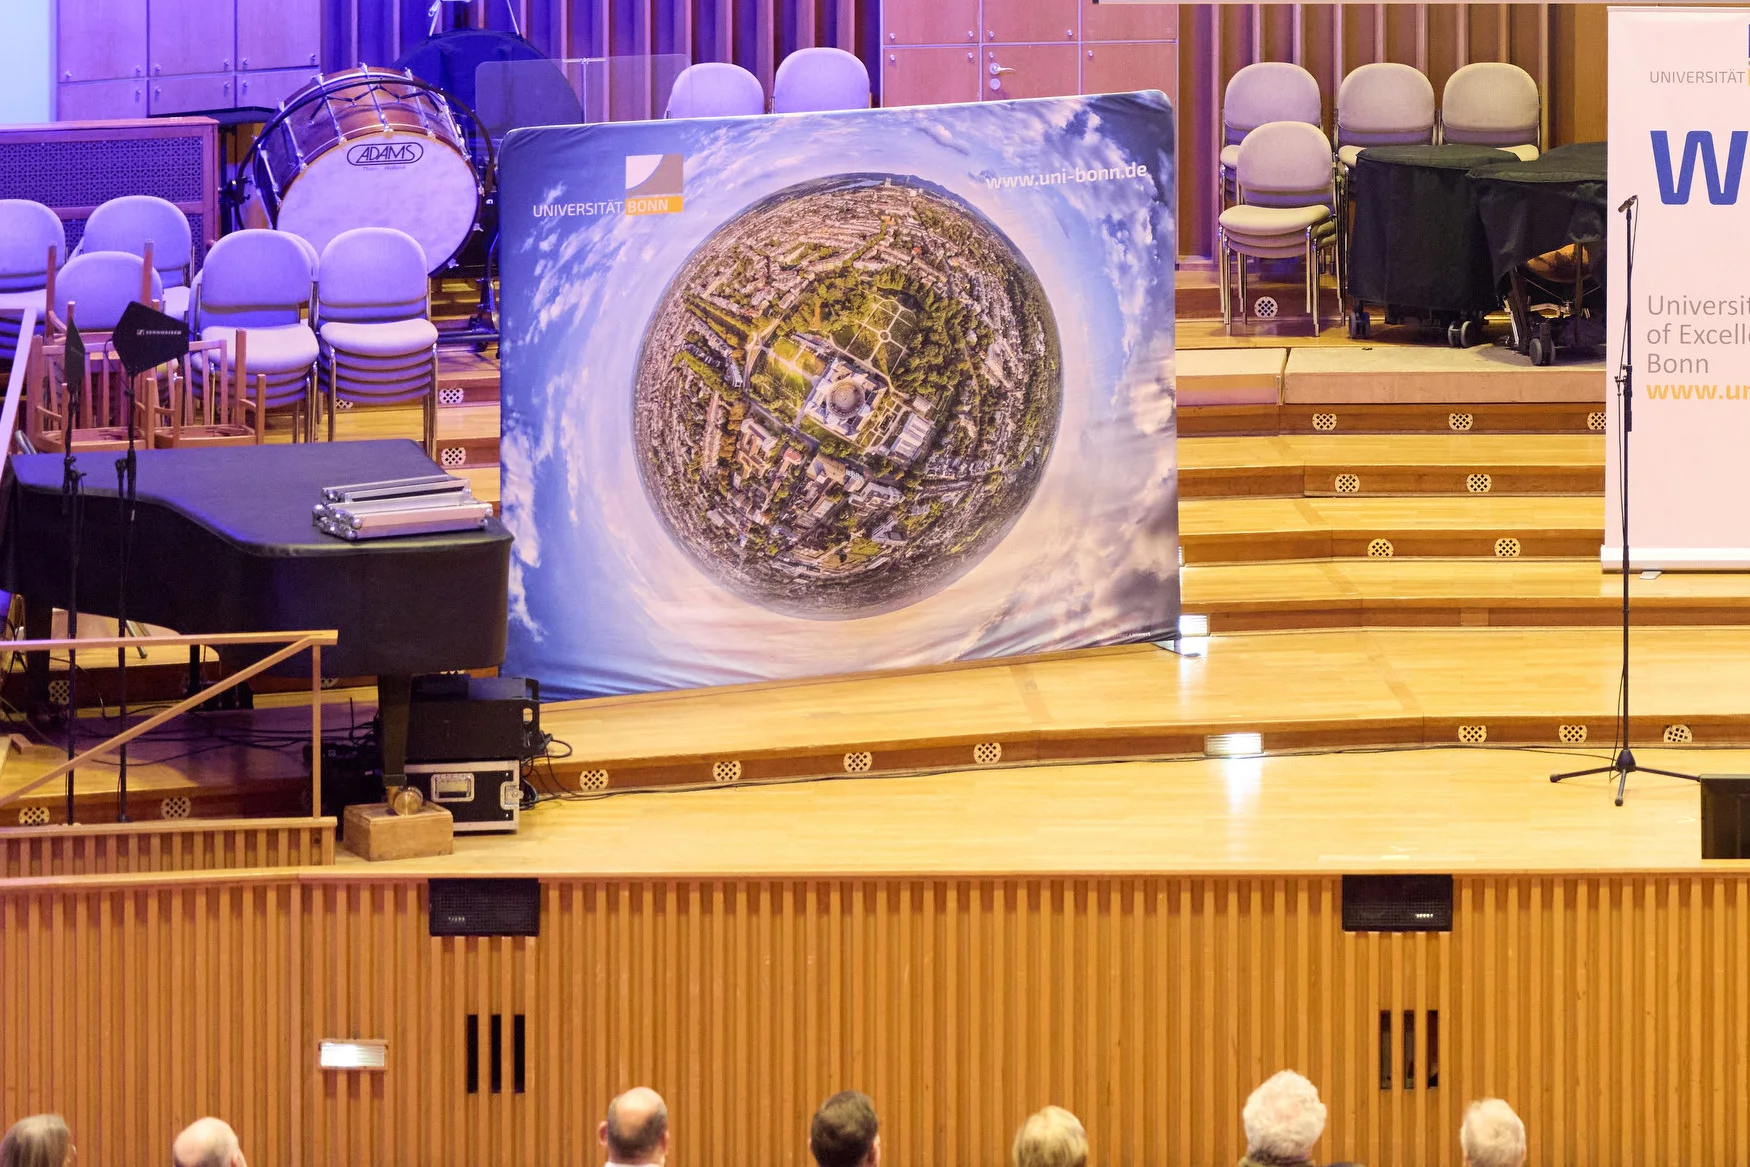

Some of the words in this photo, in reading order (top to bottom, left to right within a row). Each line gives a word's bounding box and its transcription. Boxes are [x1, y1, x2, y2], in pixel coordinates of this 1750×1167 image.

[1649, 68, 1746, 85] UNIVERSITÄT
[356, 144, 416, 163] ADAMS
[985, 161, 1148, 190] www.uni-bonn.de
[532, 199, 623, 218] UNIVERSITÄT
[627, 198, 669, 214] BONN
[1646, 323, 1673, 345] of
[1646, 353, 1709, 375] Bonn
